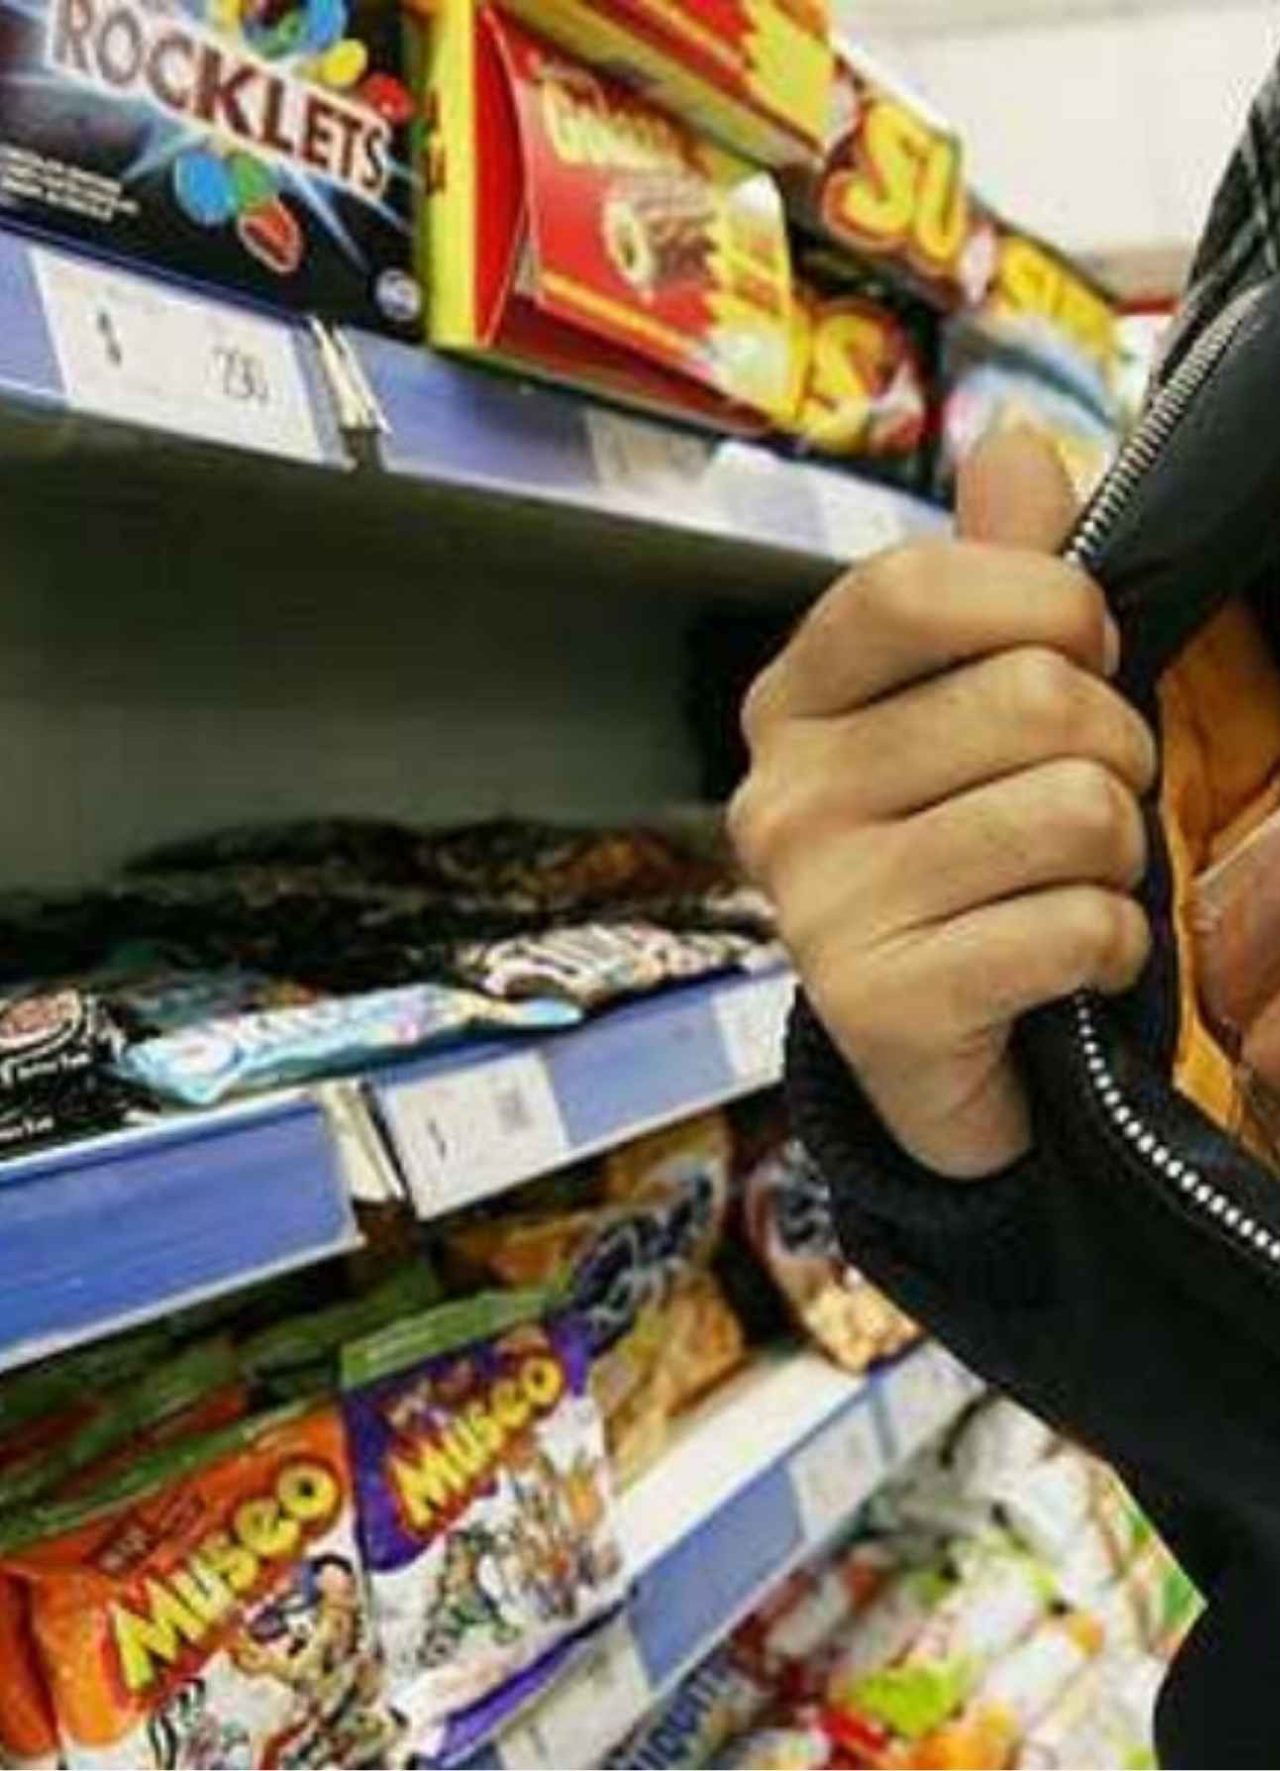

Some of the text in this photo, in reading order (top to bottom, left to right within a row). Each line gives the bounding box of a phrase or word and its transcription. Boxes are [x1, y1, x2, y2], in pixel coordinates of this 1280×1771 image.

[54, 0, 388, 194] ROCKLETS
[391, 1356, 564, 1530] Museo
[107, 1461, 339, 1693] Museo
